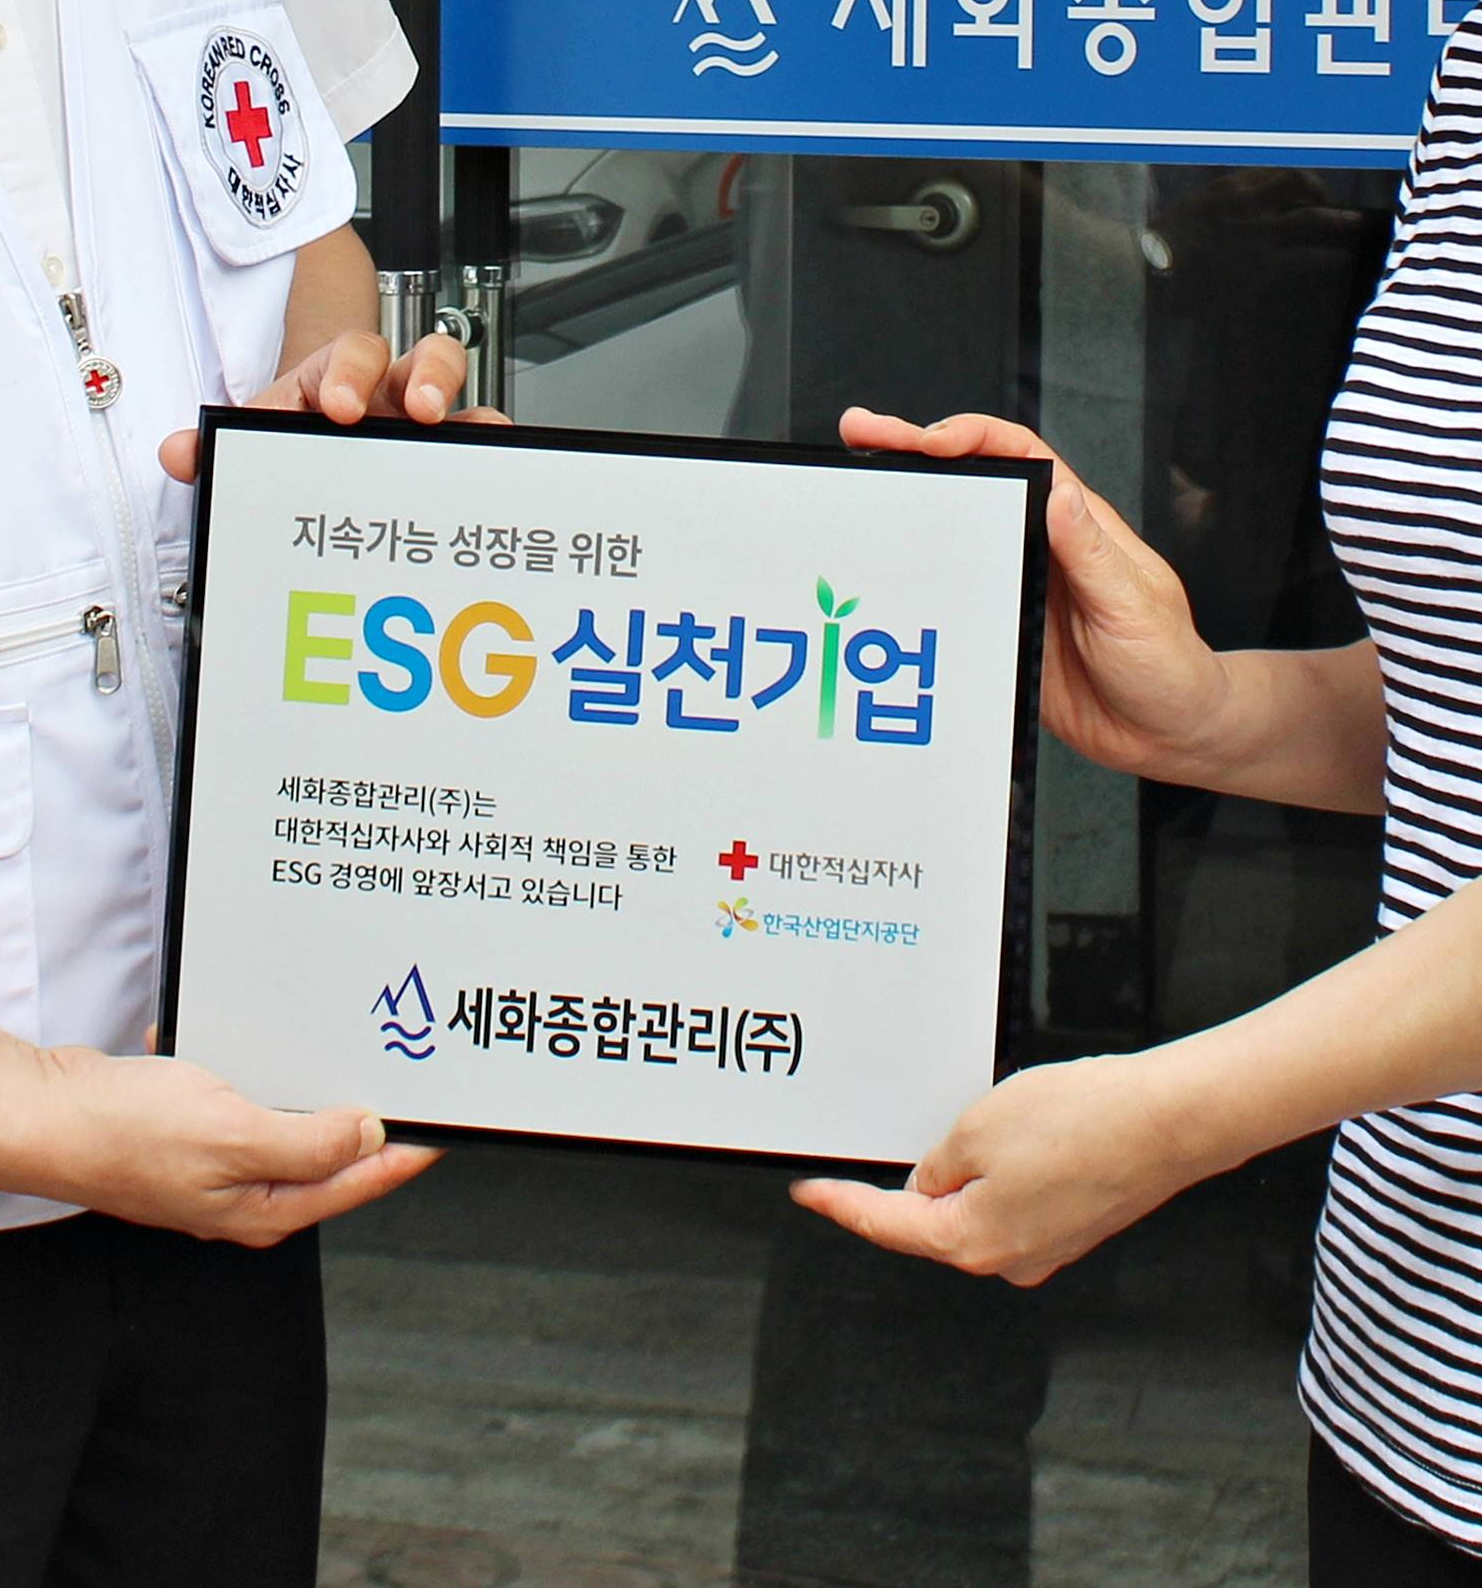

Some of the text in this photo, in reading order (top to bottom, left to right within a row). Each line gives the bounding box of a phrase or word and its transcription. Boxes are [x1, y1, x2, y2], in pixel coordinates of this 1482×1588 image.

[199, 43, 225, 130] KOREAN
[221, 35, 246, 61] RED
[292, 512, 643, 578] 지속가능 성장을 위한
[282, 589, 939, 746] ESG 실천기업
[277, 775, 497, 819] 세화종합관리(주)는
[274, 817, 678, 874] 대한적십자사와 사회적 책임을 통한
[769, 852, 923, 889] 대한적십자사
[272, 859, 624, 911] ESG 경영에 앞장서고 있습니다
[763, 913, 921, 946] 한국산업단지공단
[447, 986, 804, 1076] 세화종합관리(주)
